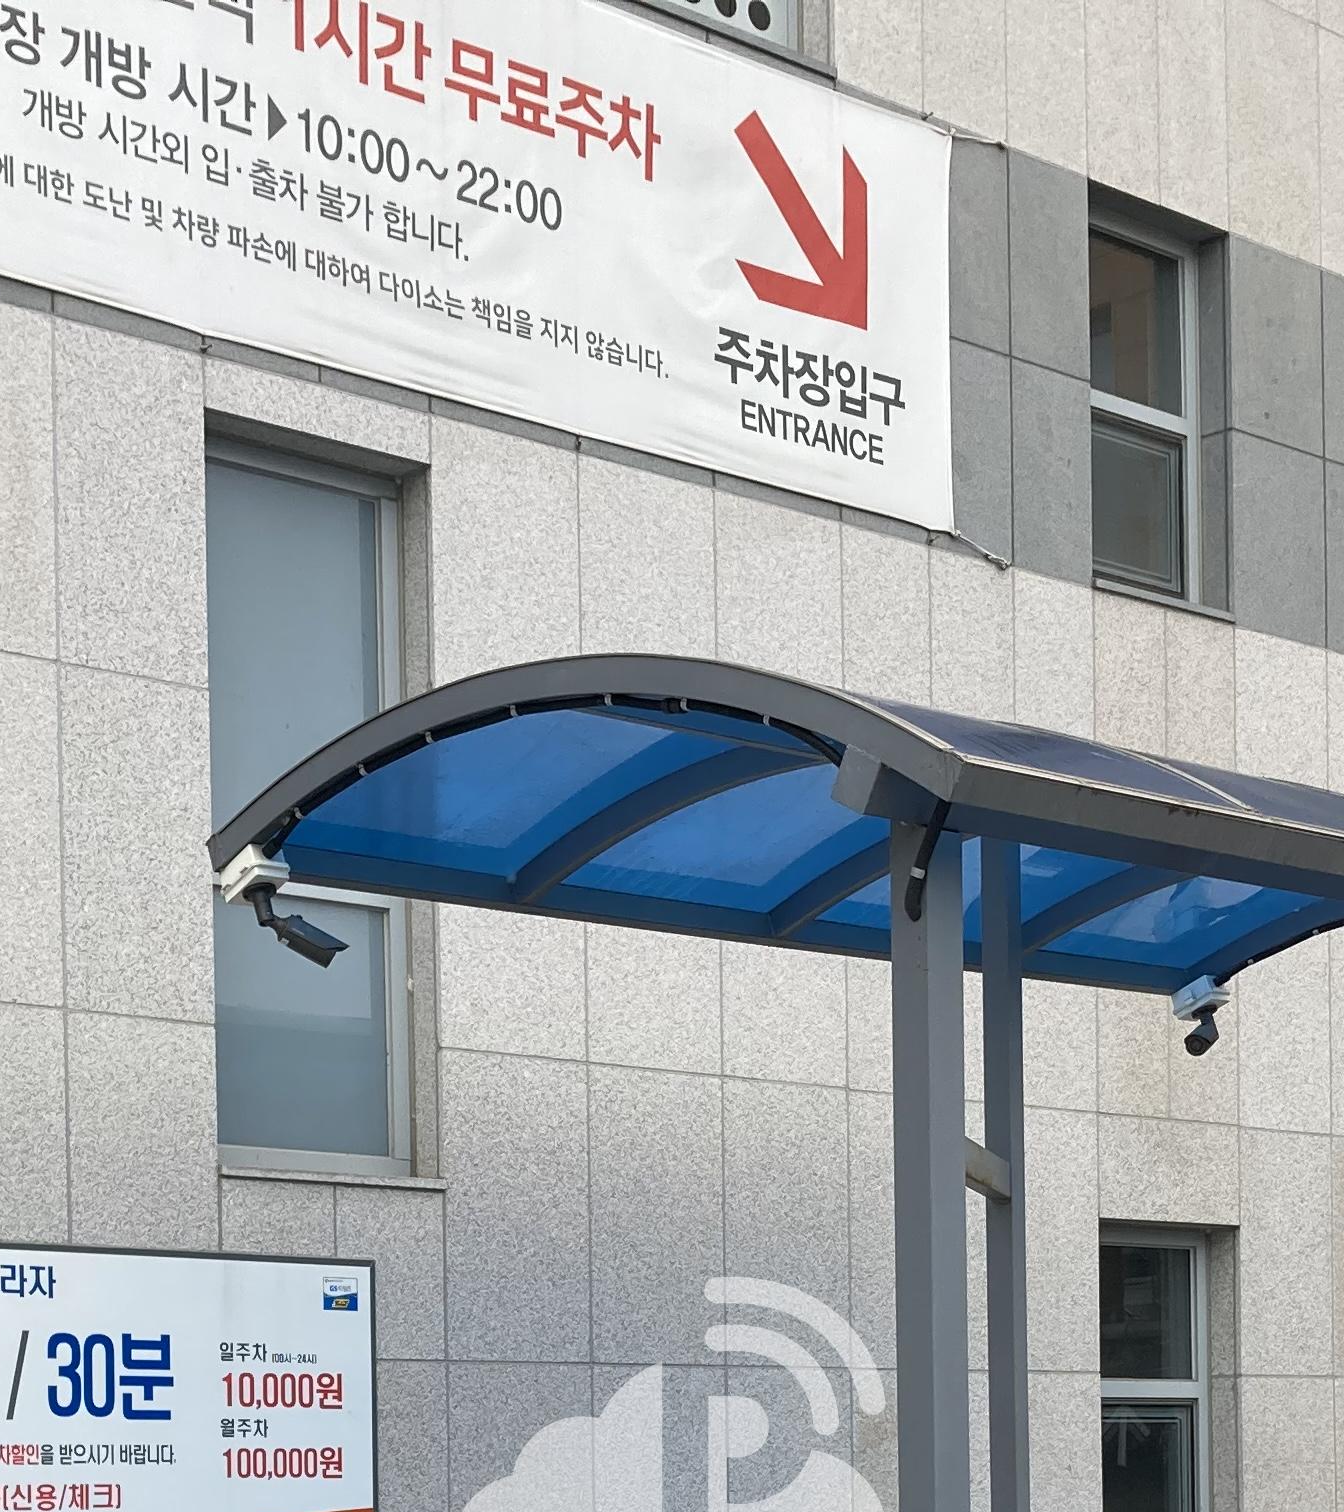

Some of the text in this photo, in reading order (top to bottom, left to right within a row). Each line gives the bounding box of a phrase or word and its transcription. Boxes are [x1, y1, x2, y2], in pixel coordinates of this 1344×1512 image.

[60, 26, 152, 100] 개방
[168, 61, 259, 136] 시간
[297, 108, 563, 231] 10:00~22:00
[444, 36, 662, 182] 무료주차
[23, 89, 87, 140] 개방
[98, 110, 190, 174] 시간외
[316, 179, 374, 232] 불가
[382, 202, 470, 262] 합니다.
[24, 161, 75, 203] 대한
[82, 179, 133, 222] 도난
[141, 196, 164, 232] 및
[172, 206, 219, 248] 차량
[227, 222, 297, 272] 파손에
[304, 244, 371, 295] 대하여
[379, 271, 466, 320] 다이소는
[471, 295, 533, 340] 책임을
[540, 316, 579, 354] 지지
[585, 329, 670, 379] 않습니다.
[713, 325, 906, 429] 주차장입구
[741, 401, 885, 466] ENTRANCE
[47, 1333, 174, 1421] 30분
[219, 1342, 267, 1363] 일주차
[220, 1418, 269, 1438] 월주차
[222, 1372, 343, 1410] 10,000원
[59, 1443, 115, 1467] 받으시기
[119, 1443, 177, 1467] 바랍니다.
[222, 1447, 343, 1480] 100,000원
